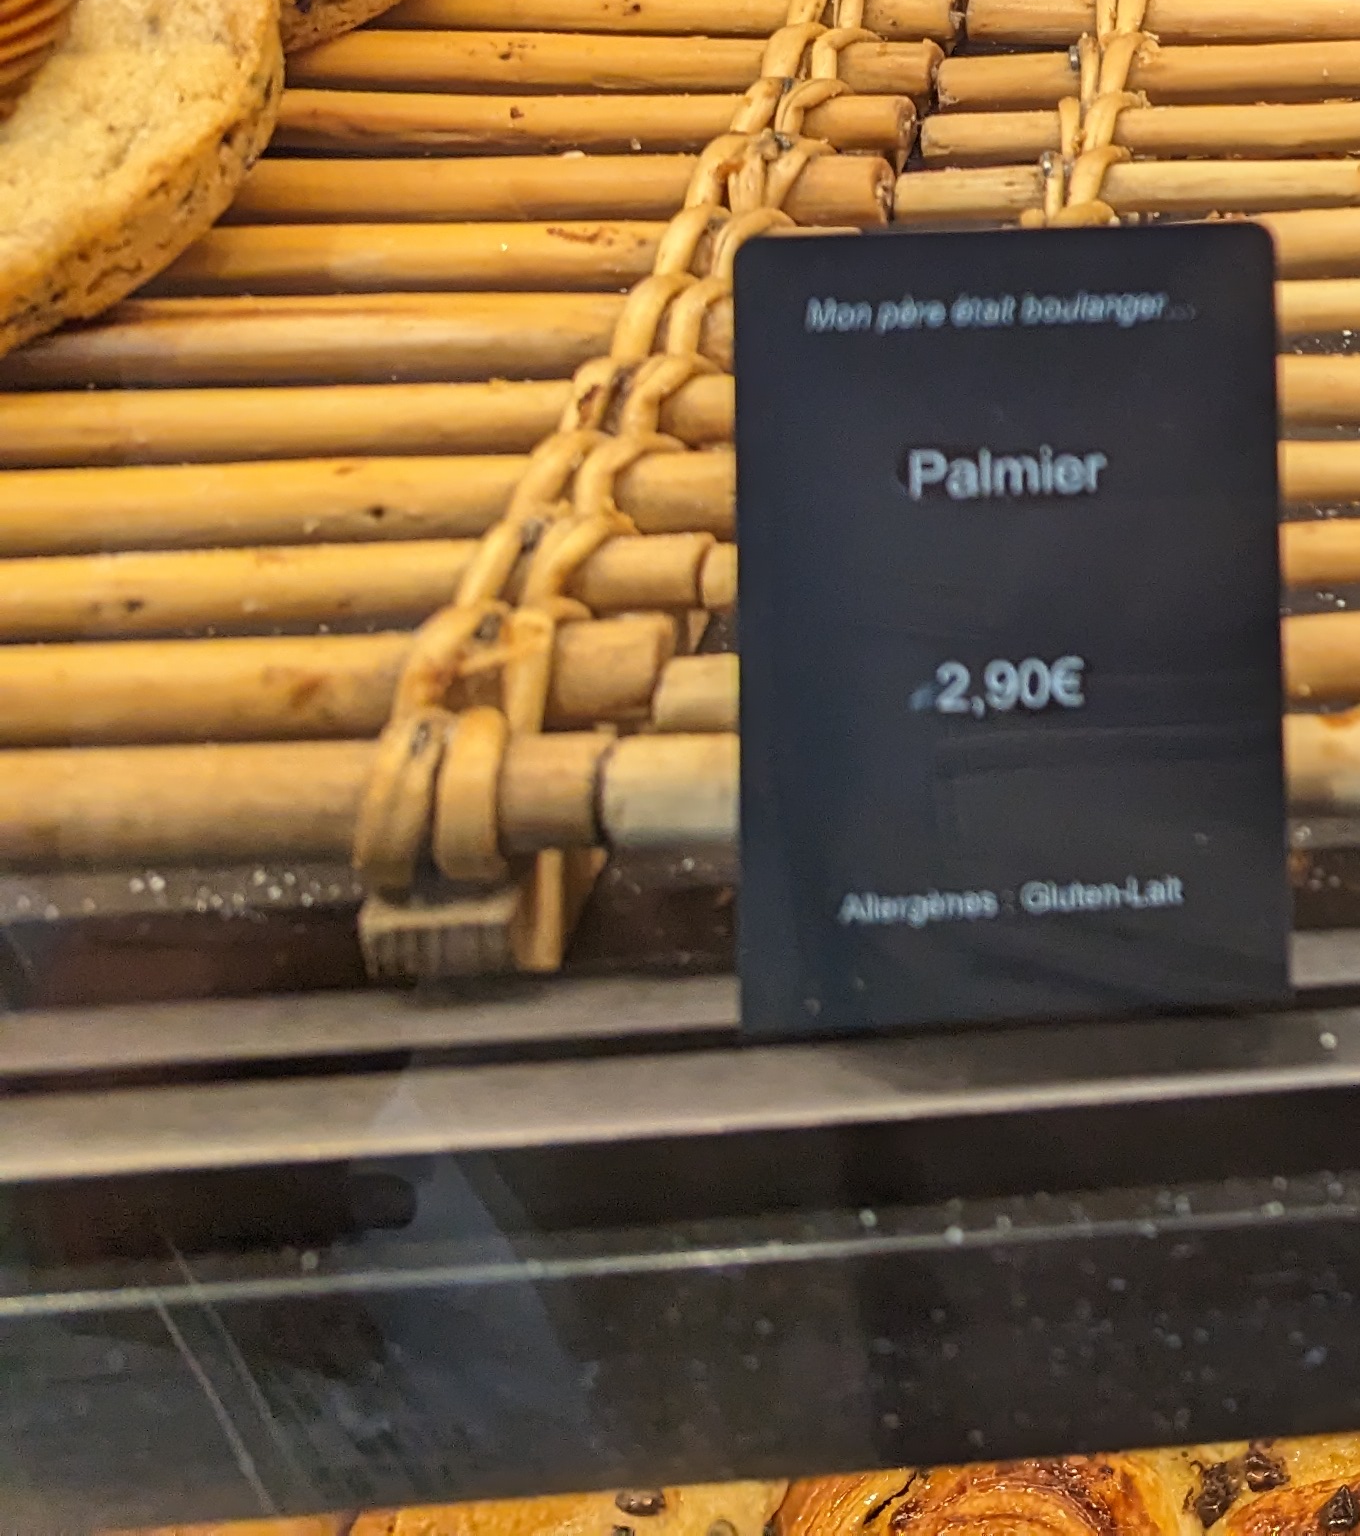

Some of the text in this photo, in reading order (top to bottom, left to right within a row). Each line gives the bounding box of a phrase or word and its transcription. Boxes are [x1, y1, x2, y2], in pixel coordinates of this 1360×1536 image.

[806, 296, 872, 332] Mon
[874, 293, 946, 335] père
[951, 292, 1017, 328] était
[908, 444, 1107, 500] Palmier
[935, 655, 1086, 718] 2,90€
[838, 888, 999, 928] Allergènes
